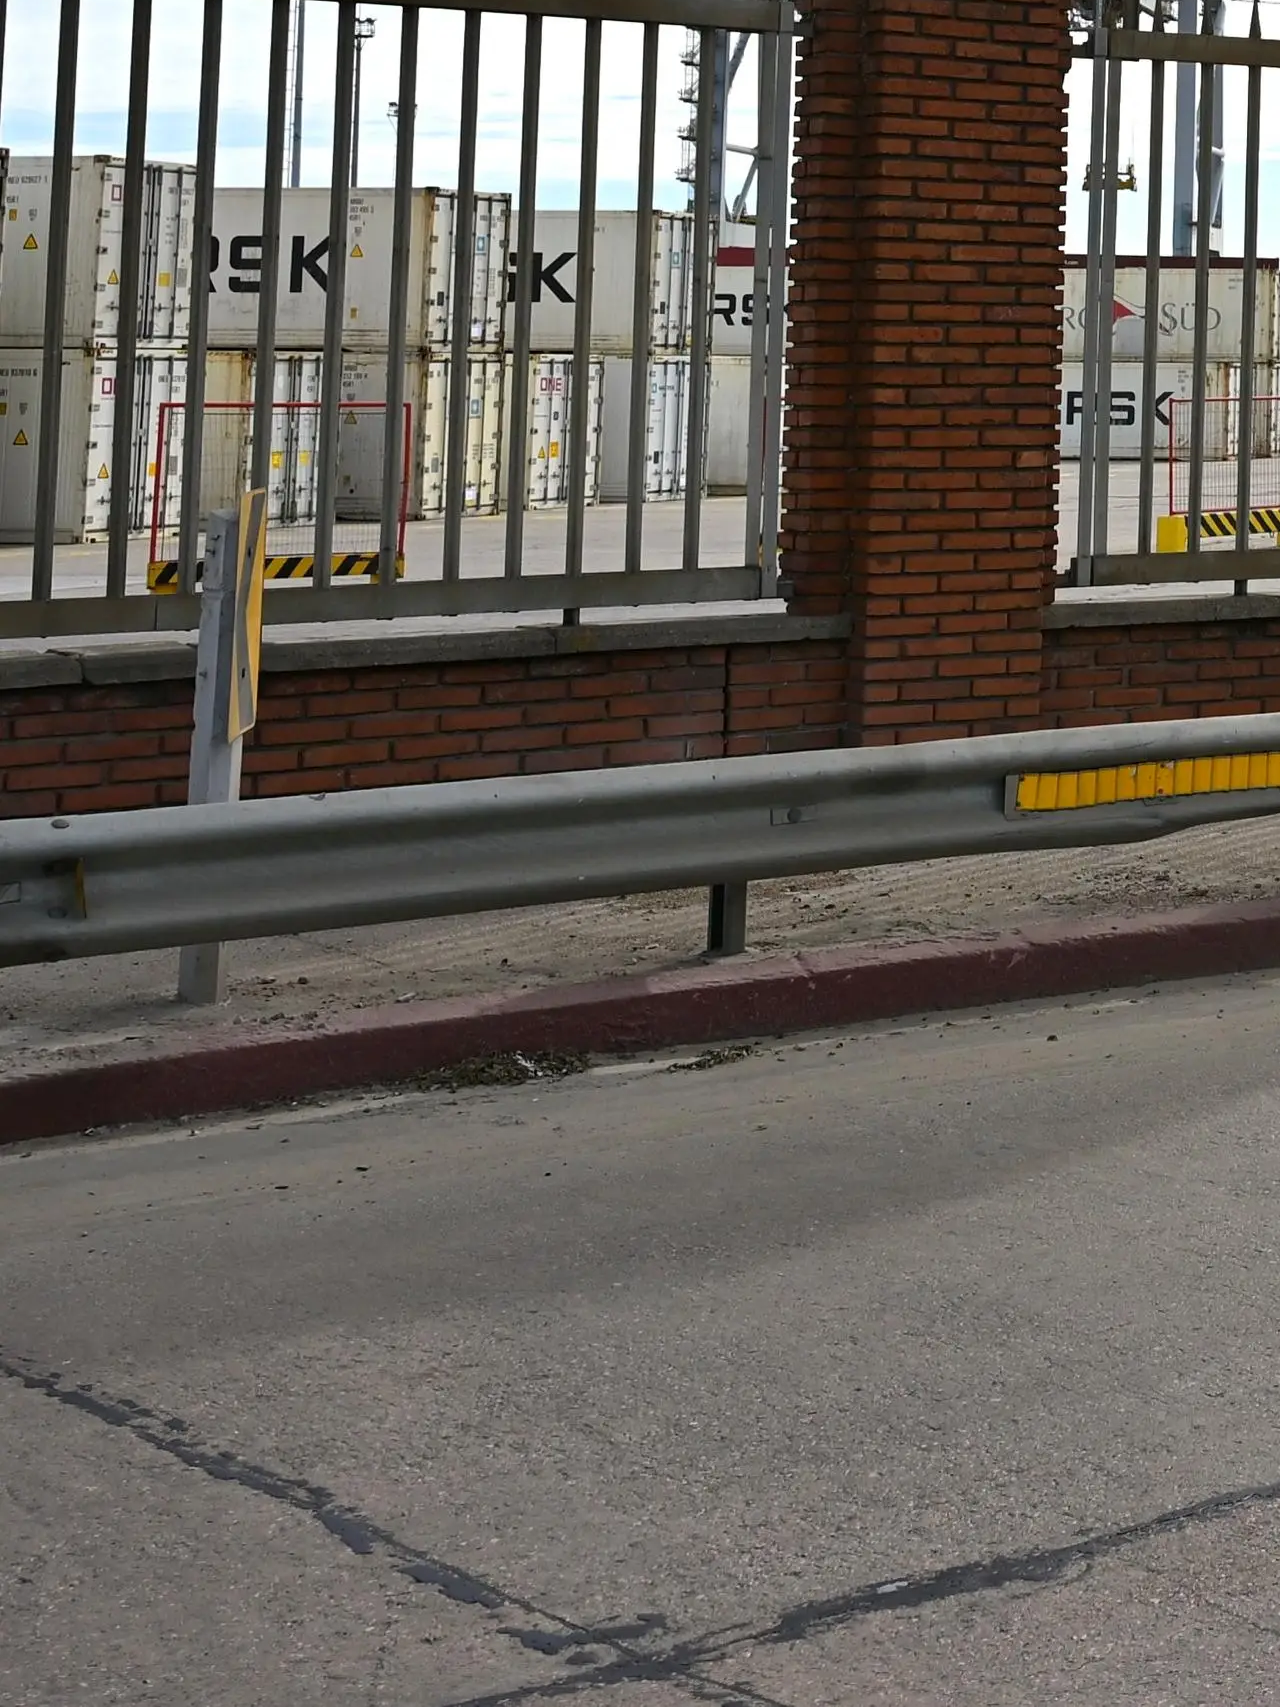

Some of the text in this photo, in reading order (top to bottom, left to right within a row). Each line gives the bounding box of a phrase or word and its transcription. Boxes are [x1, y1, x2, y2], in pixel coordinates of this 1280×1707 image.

[207, 235, 330, 293] SK
[508, 252, 578, 302] K
[714, 293, 789, 326] RS
